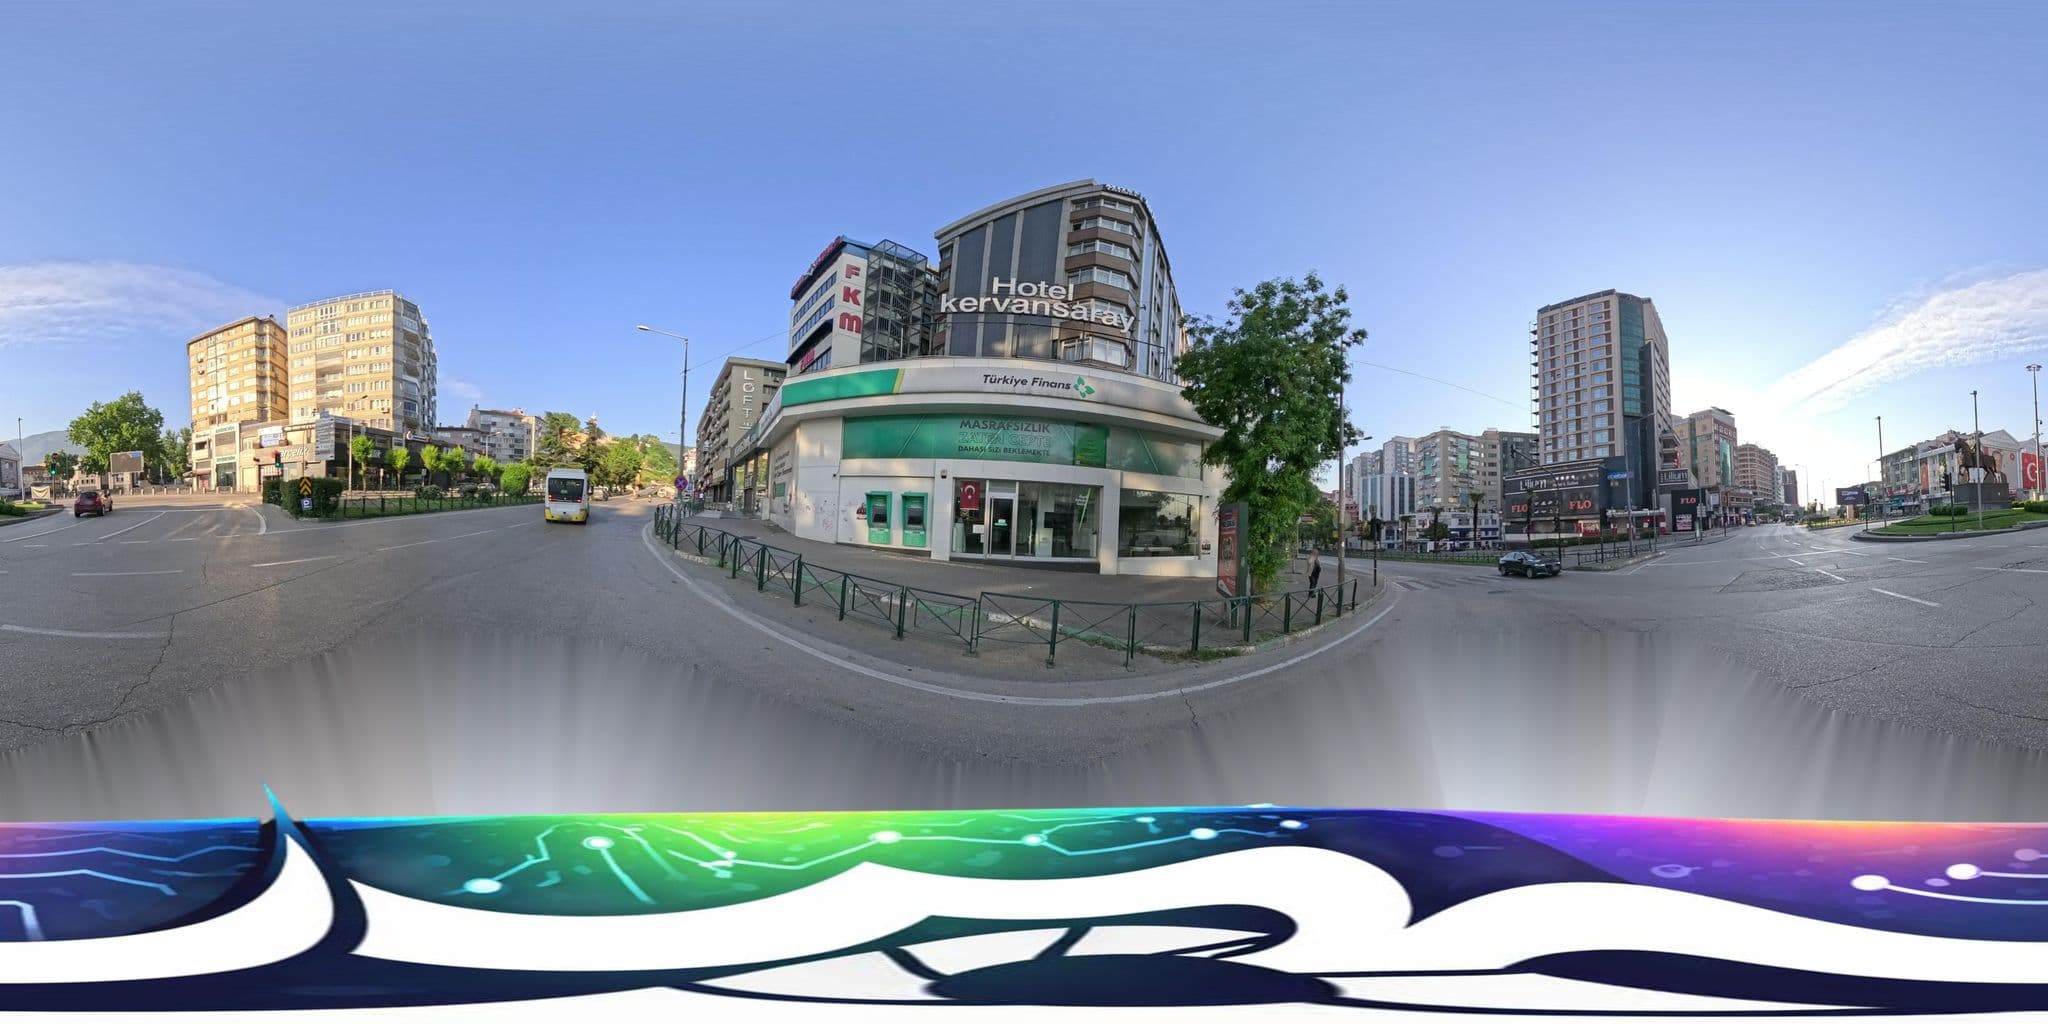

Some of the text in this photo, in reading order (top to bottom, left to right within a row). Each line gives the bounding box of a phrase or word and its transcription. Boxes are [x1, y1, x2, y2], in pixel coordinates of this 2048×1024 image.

[992, 276, 1075, 302] Hotel
[839, 263, 863, 335] FKM
[940, 293, 1136, 333] kervansaray
[983, 374, 1072, 390] Türkiye Finans
[742, 369, 755, 418] LOFT
[960, 419, 1050, 433] MASRAFSIZLIK
[1511, 504, 1528, 513] FLO
[1569, 499, 1592, 510] FLO
[1680, 497, 1696, 505] FLO
